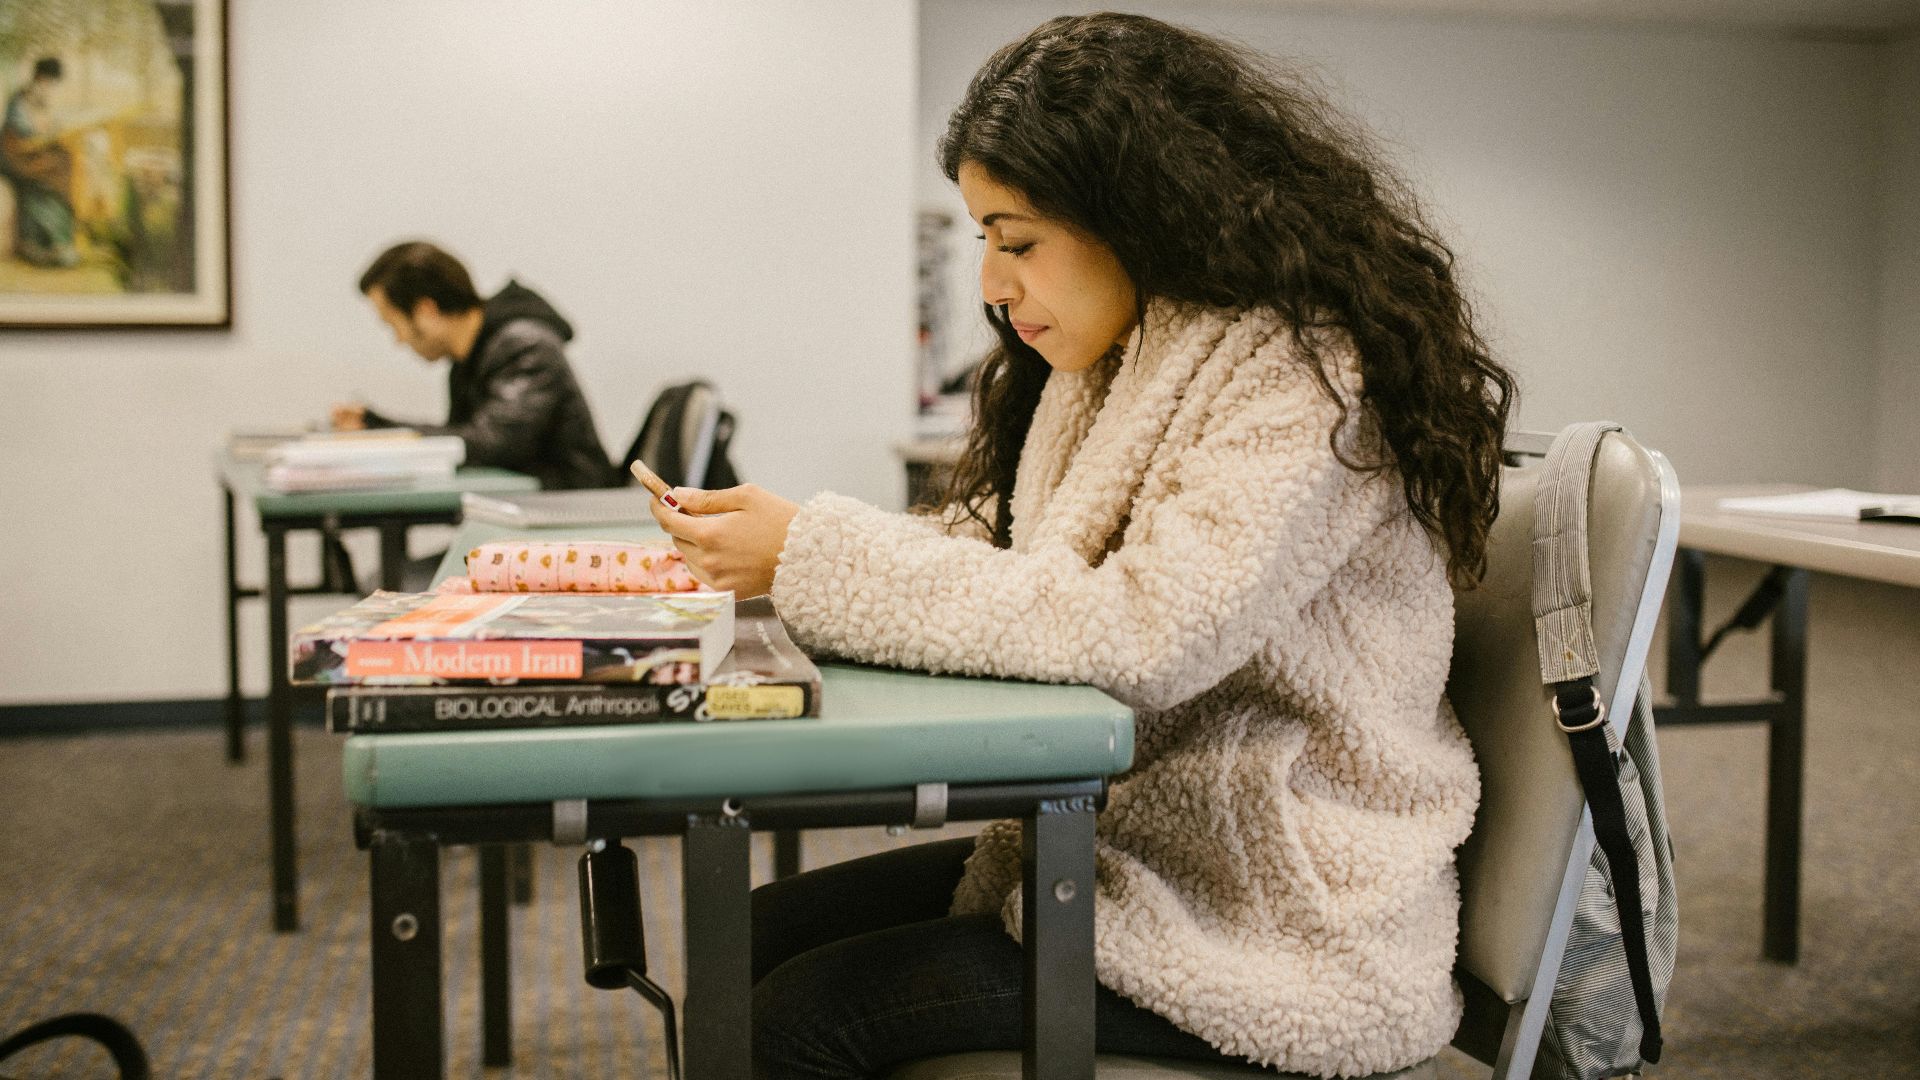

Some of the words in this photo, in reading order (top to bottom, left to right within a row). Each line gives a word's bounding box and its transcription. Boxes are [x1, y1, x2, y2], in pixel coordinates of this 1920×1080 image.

[404, 644, 510, 674] Modern
[521, 644, 577, 673] Iran
[435, 696, 561, 720] BIOLOGICAL
